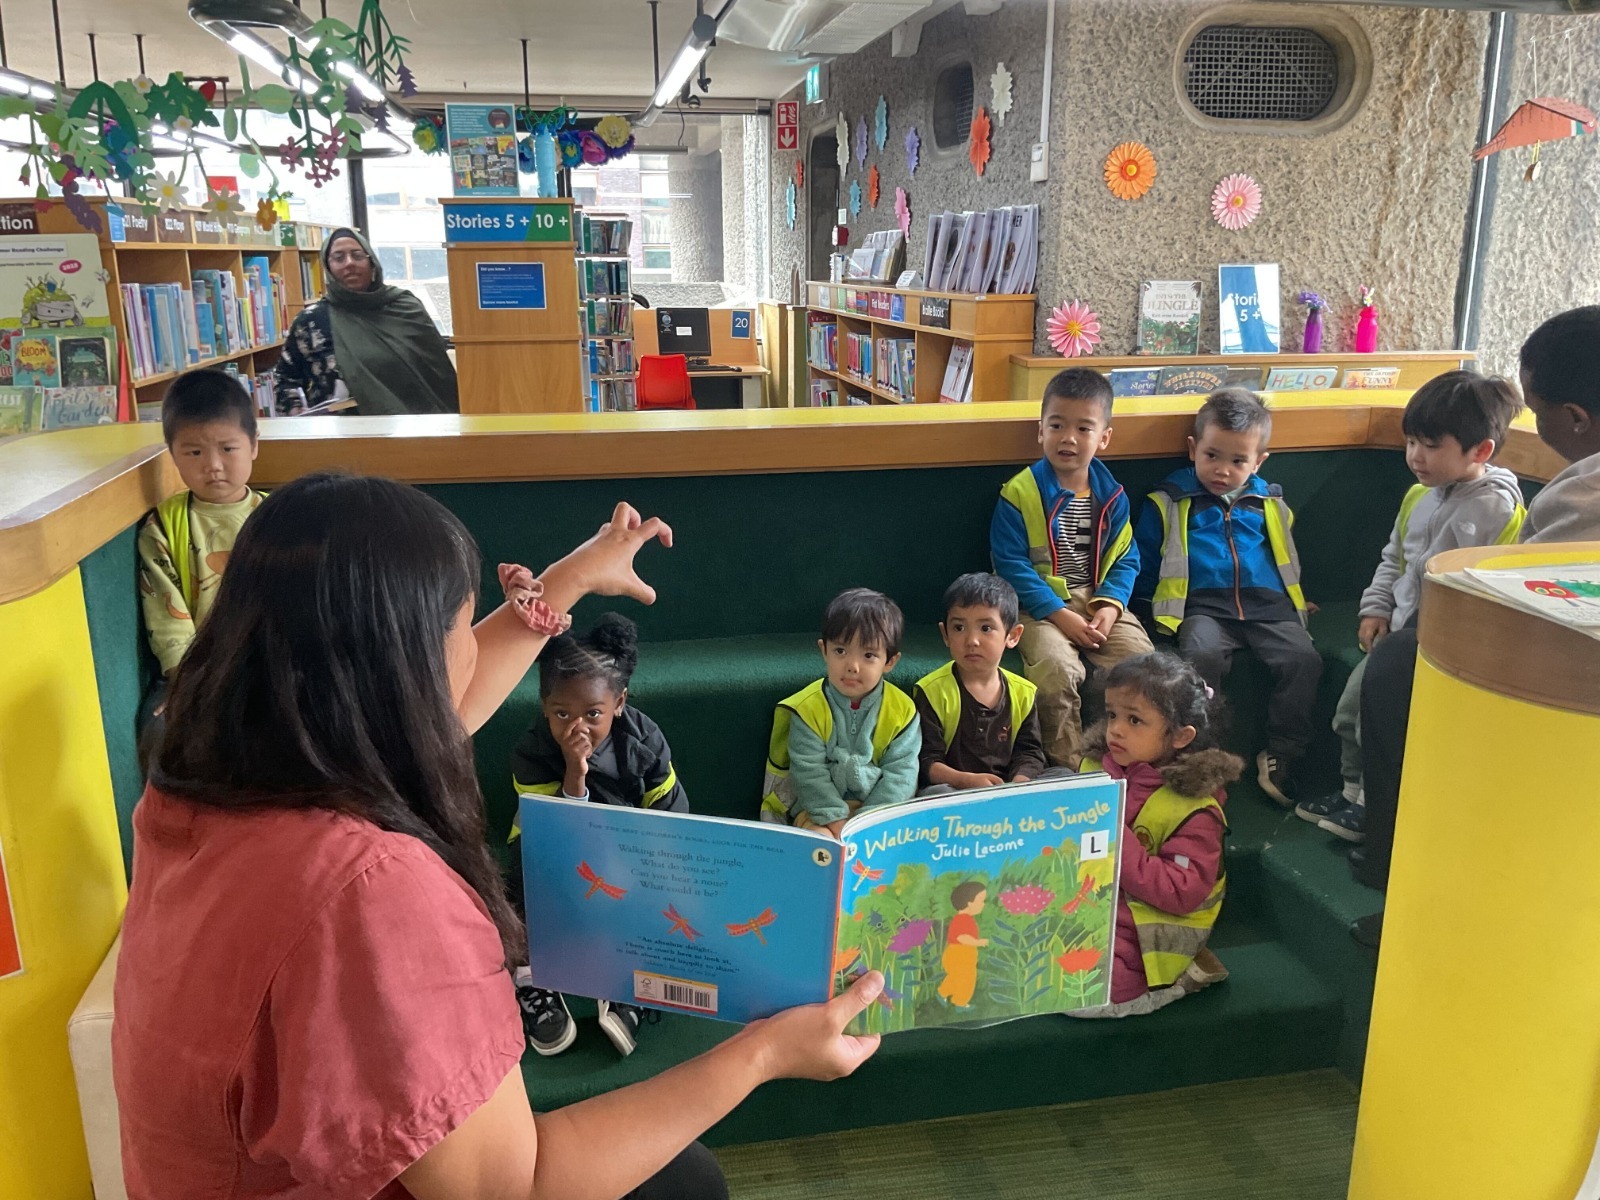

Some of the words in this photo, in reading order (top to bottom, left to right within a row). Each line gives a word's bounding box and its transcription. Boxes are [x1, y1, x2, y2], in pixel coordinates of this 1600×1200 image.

[0, 215, 34, 230] tion
[446, 213, 501, 229] Stories
[505, 213, 515, 229] 5
[535, 213, 554, 229] 10
[734, 317, 749, 329] 20
[1239, 308, 1249, 322] 5
[21, 346, 47, 357] BLOOM
[864, 826, 940, 859] Walking
[942, 815, 1013, 839] Through
[1018, 816, 1046, 833] the
[1050, 800, 1111, 830] Jungle
[618, 843, 655, 858] Walking
[657, 849, 693, 862] through
[695, 854, 711, 863] the
[931, 843, 970, 861] Julie
[974, 838, 1025, 859] Lacome
[1090, 836, 1102, 854] L
[640, 858, 665, 868] What
[667, 862, 679, 870] do
[681, 865, 700, 873] you
[701, 867, 720, 875] see?
[630, 868, 649, 878] Can
[651, 873, 668, 881] you
[671, 873, 690, 883] hear
[639, 880, 664, 891] What
[666, 886, 692, 895] could
[703, 889, 719, 898] be?
